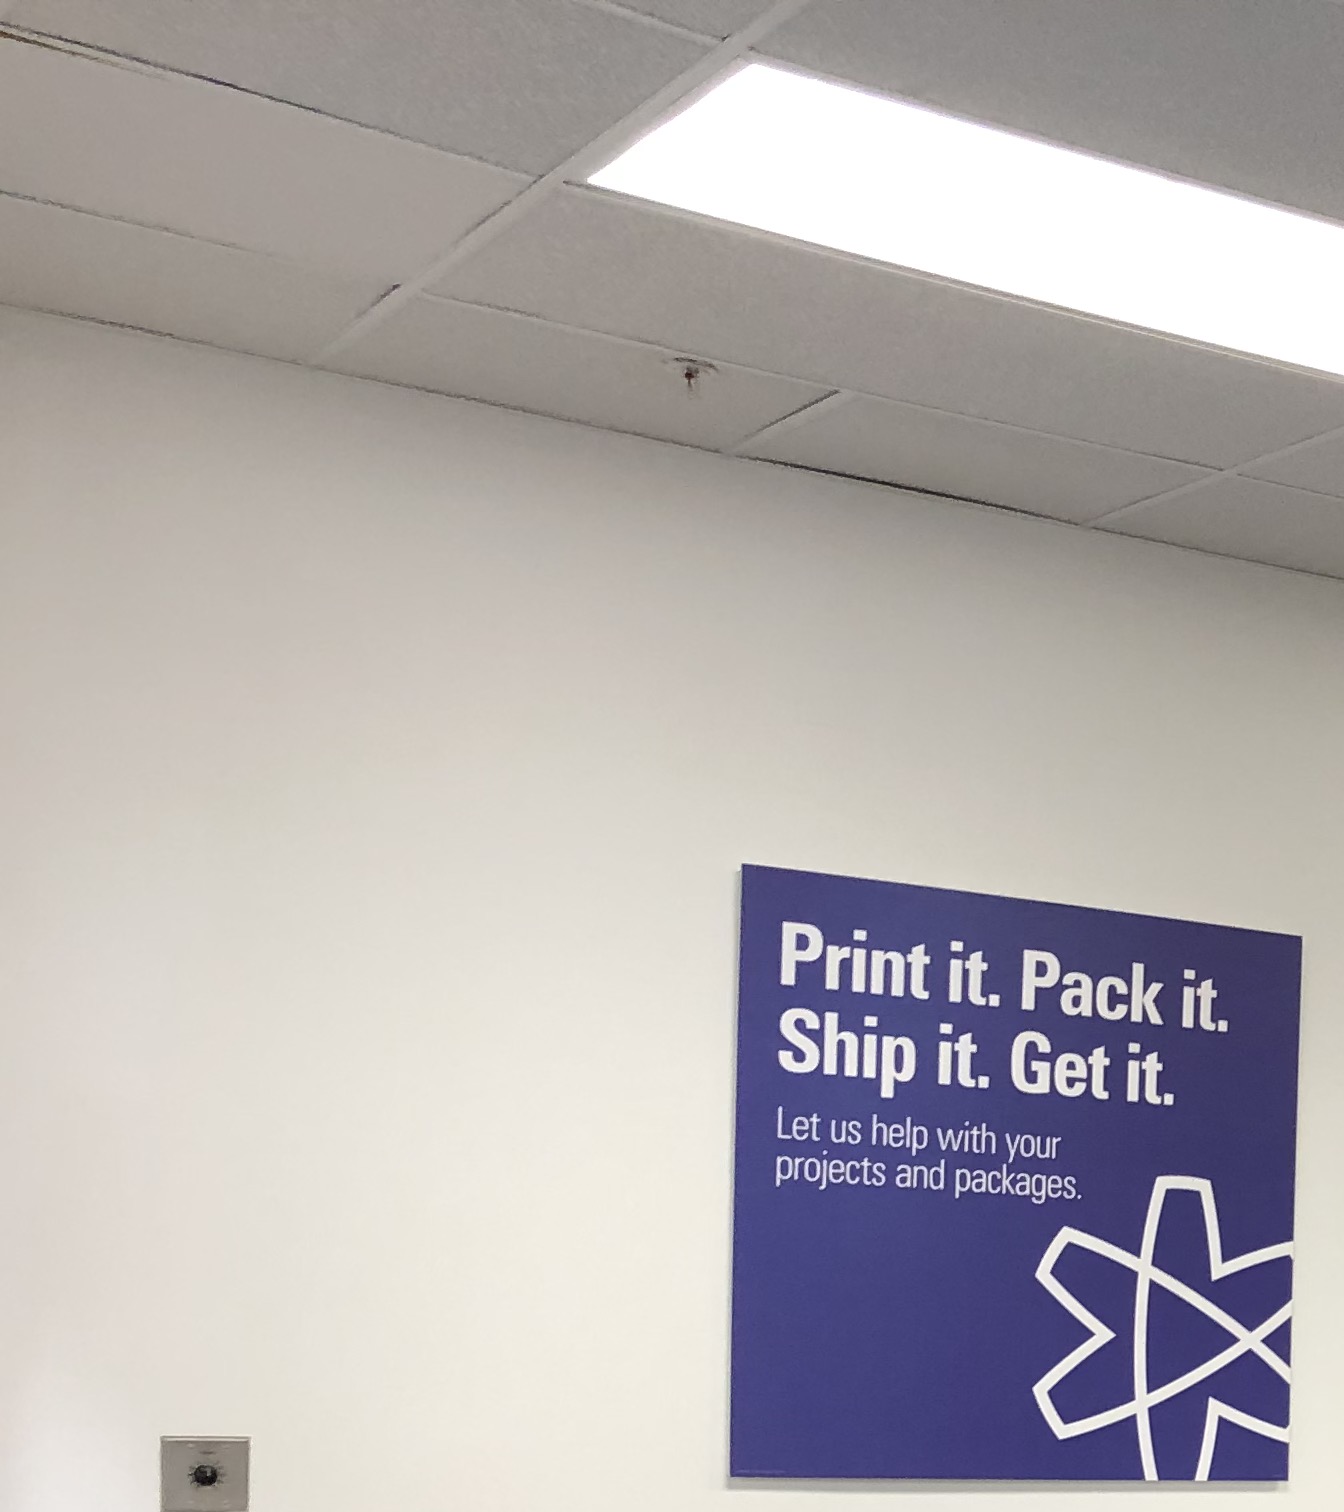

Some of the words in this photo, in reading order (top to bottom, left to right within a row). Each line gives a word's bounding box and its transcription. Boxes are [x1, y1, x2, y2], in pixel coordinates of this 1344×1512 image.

[779, 920, 932, 1002] Print
[947, 940, 1001, 1007] it.
[1020, 949, 1165, 1026] Pack
[1180, 968, 1230, 1033] it.
[777, 1007, 917, 1099] Ship
[937, 1023, 990, 1089] it.
[1010, 1030, 1110, 1101] Get
[1126, 1042, 1175, 1106] it.
[776, 1105, 821, 1143] Let
[830, 1117, 863, 1146] us
[871, 1114, 929, 1157] help
[936, 1121, 997, 1155] with
[1004, 1132, 1063, 1163] your
[774, 1152, 887, 1191] projects
[895, 1158, 945, 1191] and
[953, 1162, 1082, 1205] packages.
